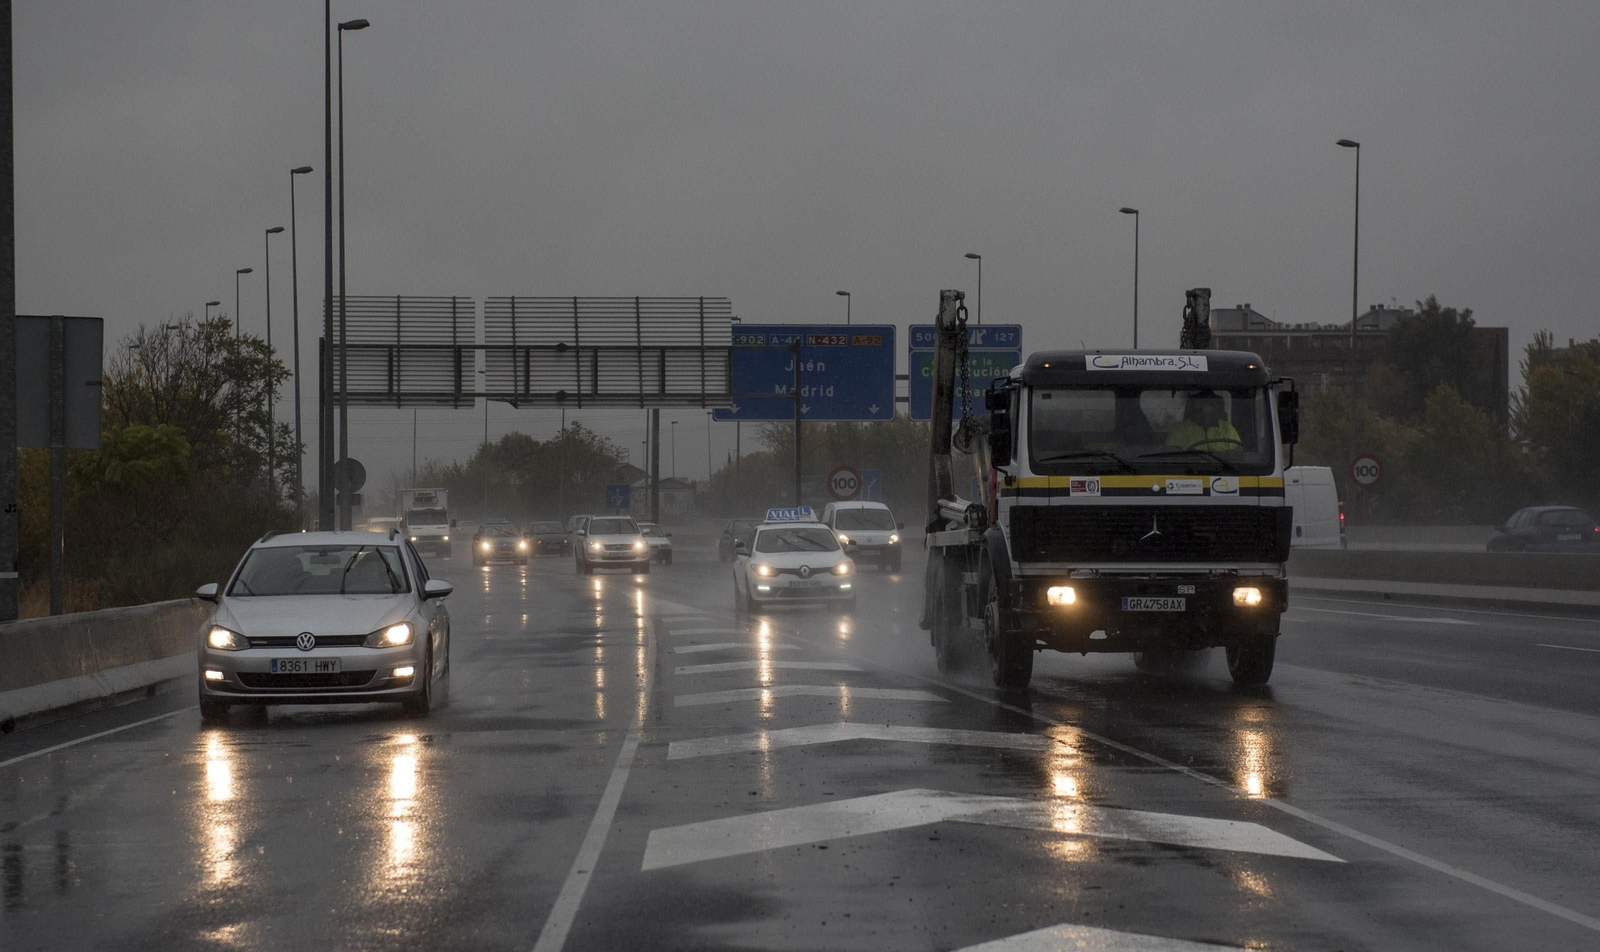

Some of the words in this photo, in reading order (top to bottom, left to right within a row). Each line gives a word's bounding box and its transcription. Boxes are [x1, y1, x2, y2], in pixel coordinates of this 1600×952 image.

[807, 336, 846, 345] N-432
[852, 336, 881, 345] A-92
[994, 332, 1015, 341] 127
[784, 359, 826, 371] Jaén
[1355, 465, 1379, 477] 100
[832, 477, 857, 490] 100
[801, 507, 808, 515] L
[1178, 585, 1195, 594] SP
[280, 660, 308, 672] 8361
[315, 660, 336, 672] HWY
